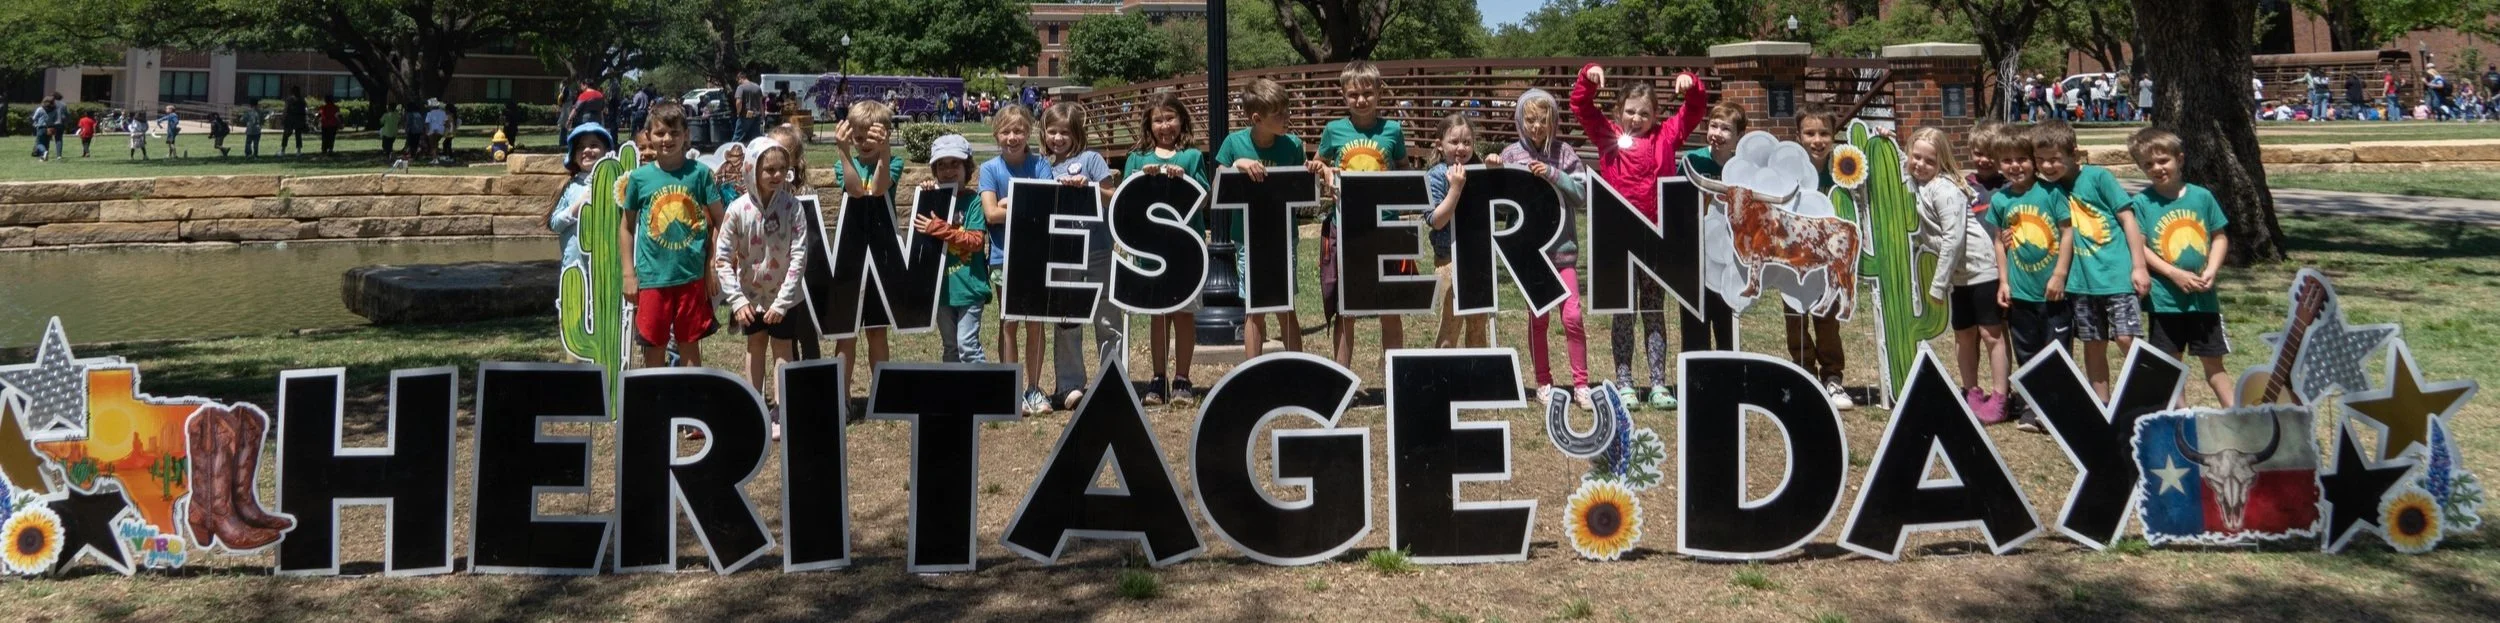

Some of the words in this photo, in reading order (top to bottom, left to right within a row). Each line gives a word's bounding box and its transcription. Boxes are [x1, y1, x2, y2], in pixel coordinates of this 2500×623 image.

[797, 165, 1704, 338] WESTERN
[2154, 208, 2197, 235] CHRISTIAN
[275, 347, 1538, 577] HERITAGE
[1677, 338, 2190, 562] DAY
[131, 536, 182, 556] YARD
